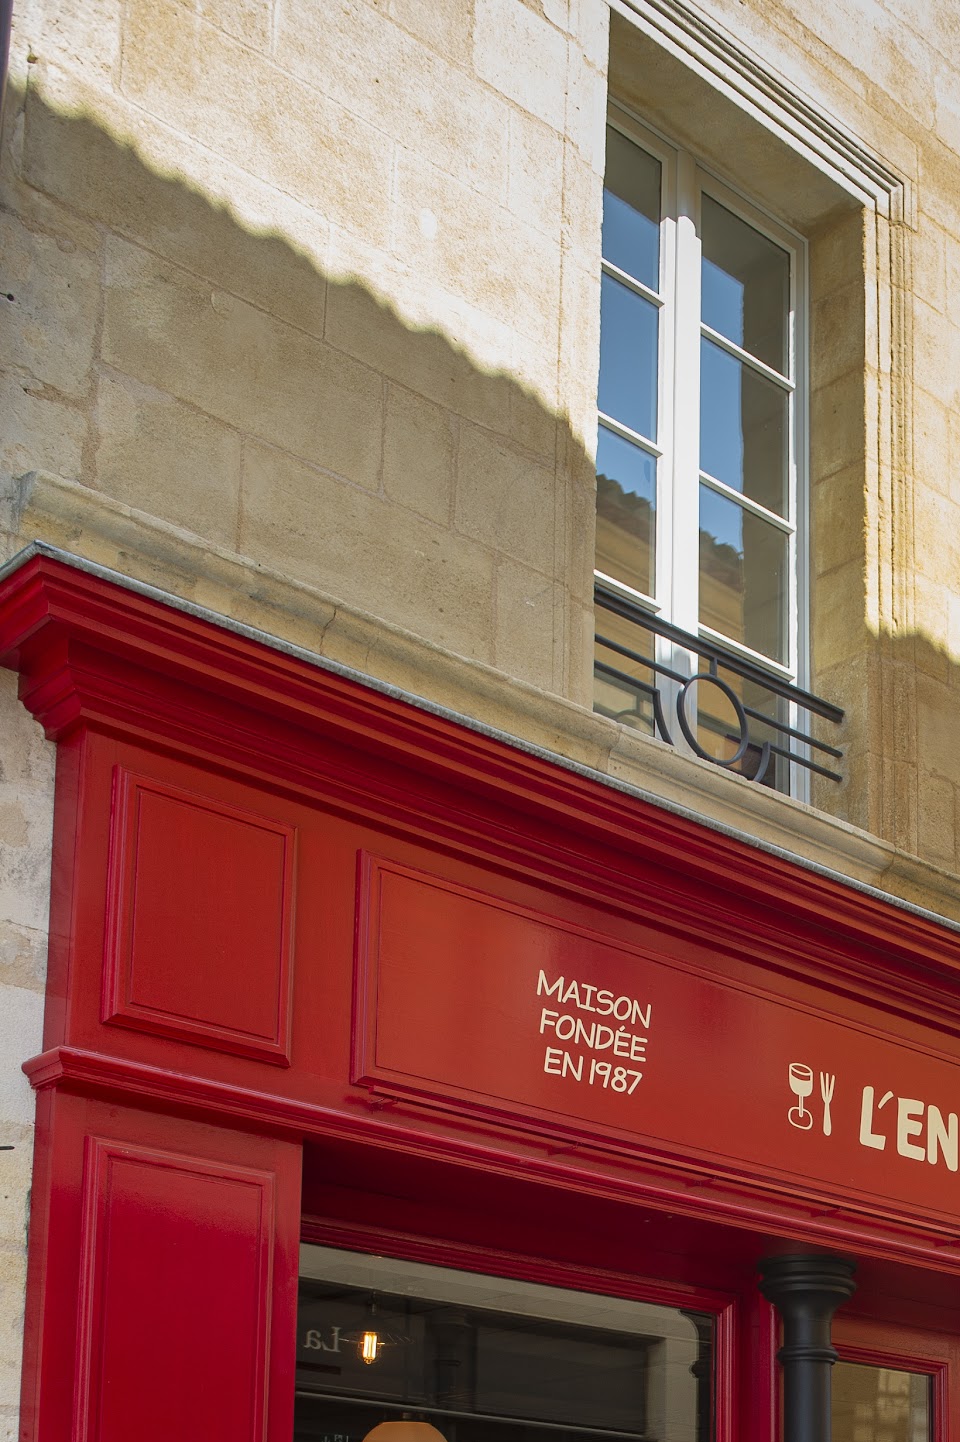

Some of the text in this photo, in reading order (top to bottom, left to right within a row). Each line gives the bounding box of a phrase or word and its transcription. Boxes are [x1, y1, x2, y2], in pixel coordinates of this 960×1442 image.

[537, 969, 651, 1029] MAISON
[540, 1008, 648, 1062] FONDÉE
[544, 1046, 643, 1095] EN 1987
